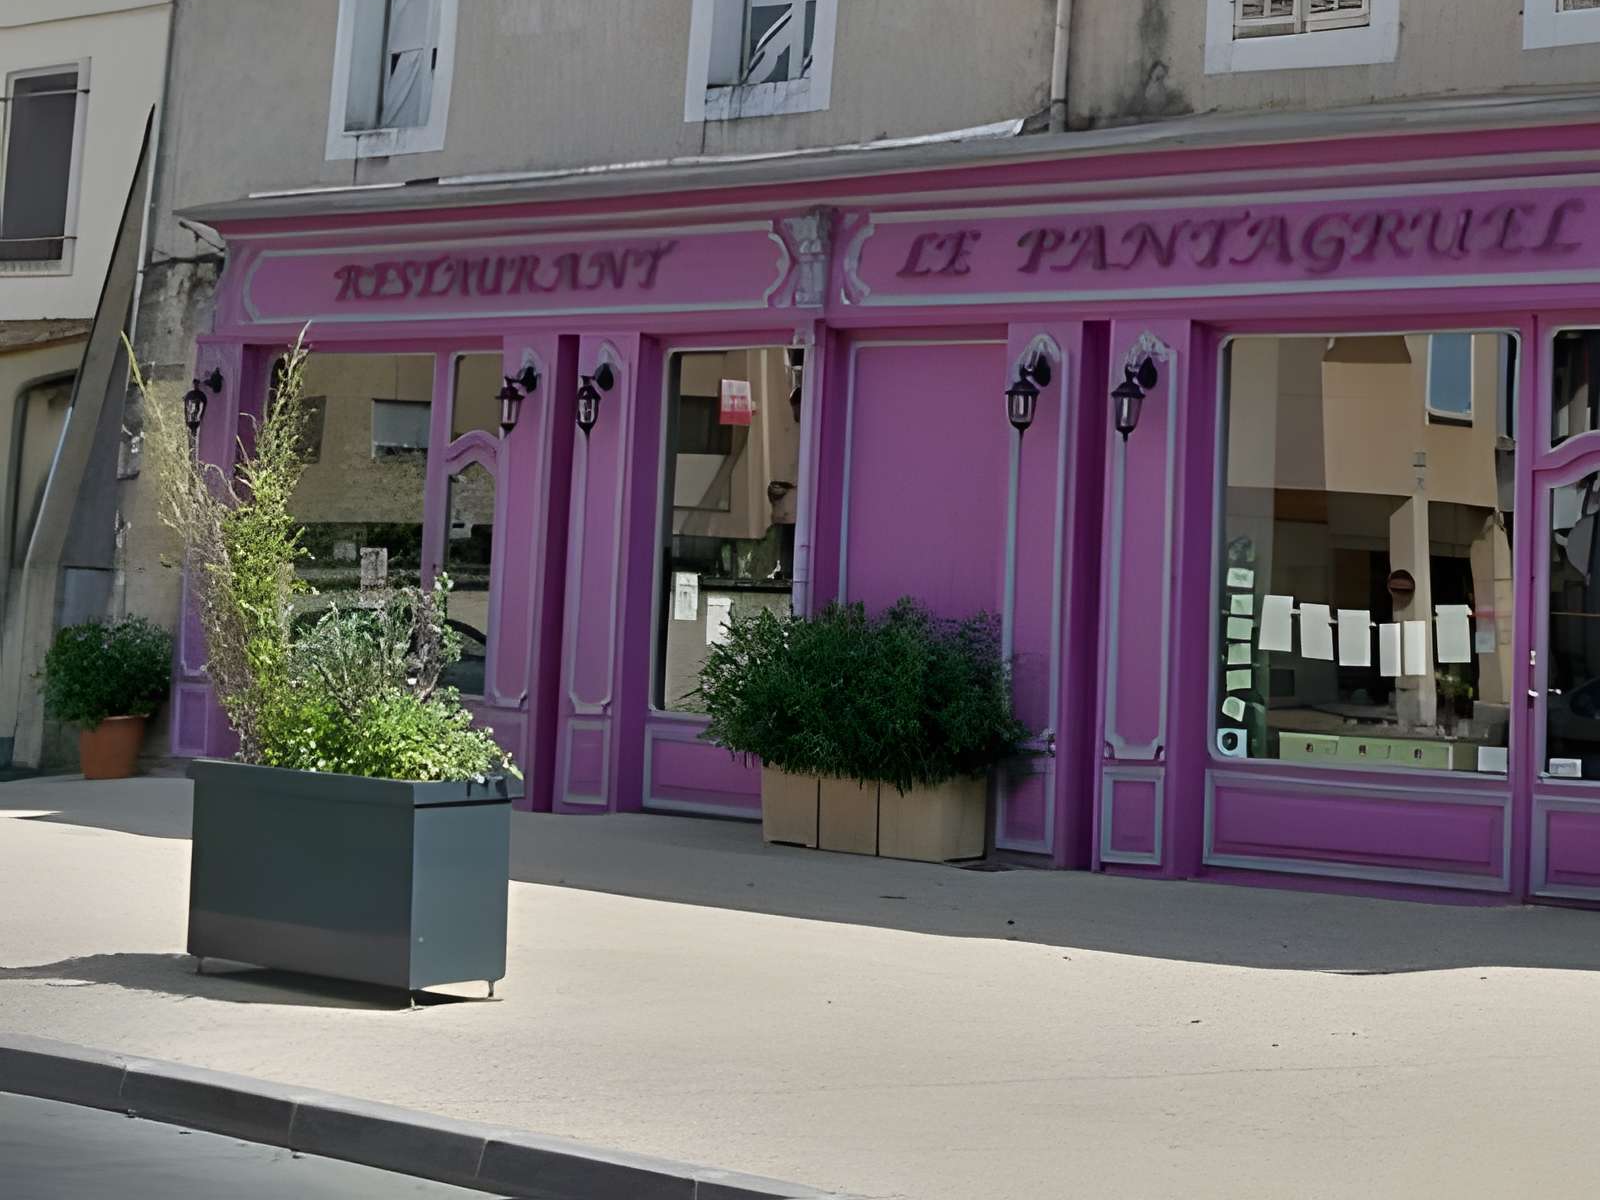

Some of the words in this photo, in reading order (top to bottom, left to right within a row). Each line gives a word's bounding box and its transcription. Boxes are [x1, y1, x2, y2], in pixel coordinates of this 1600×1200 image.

[333, 240, 680, 302] RESTAURANT
[896, 228, 982, 279] LE
[1016, 198, 1586, 275] PANTAGRUEL
